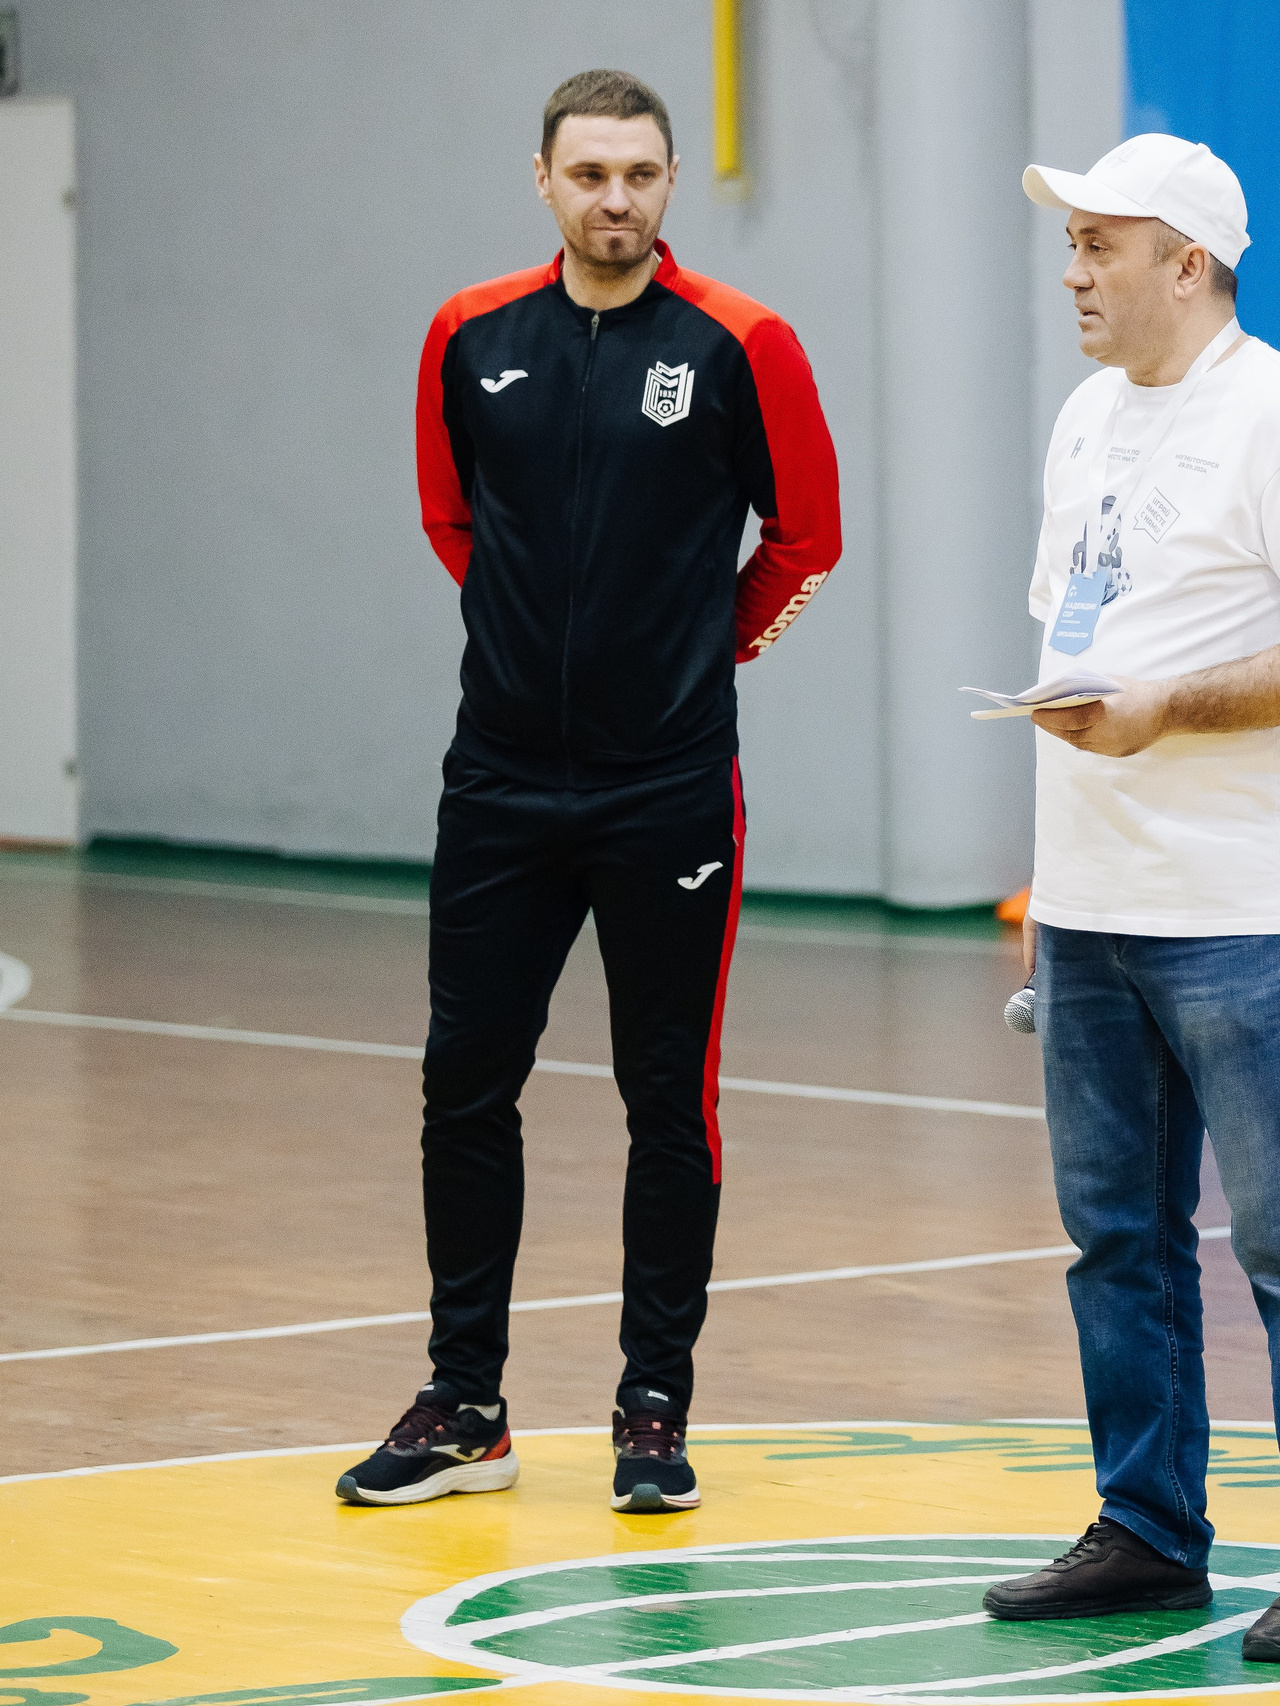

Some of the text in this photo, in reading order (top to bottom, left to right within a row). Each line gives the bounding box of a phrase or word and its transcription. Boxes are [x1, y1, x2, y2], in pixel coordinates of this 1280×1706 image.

[1177, 461, 1207, 474] 29.09.2024
[1145, 503, 1167, 527] ВМЕСТЕ
[1152, 496, 1171, 517] ИГРАЙ
